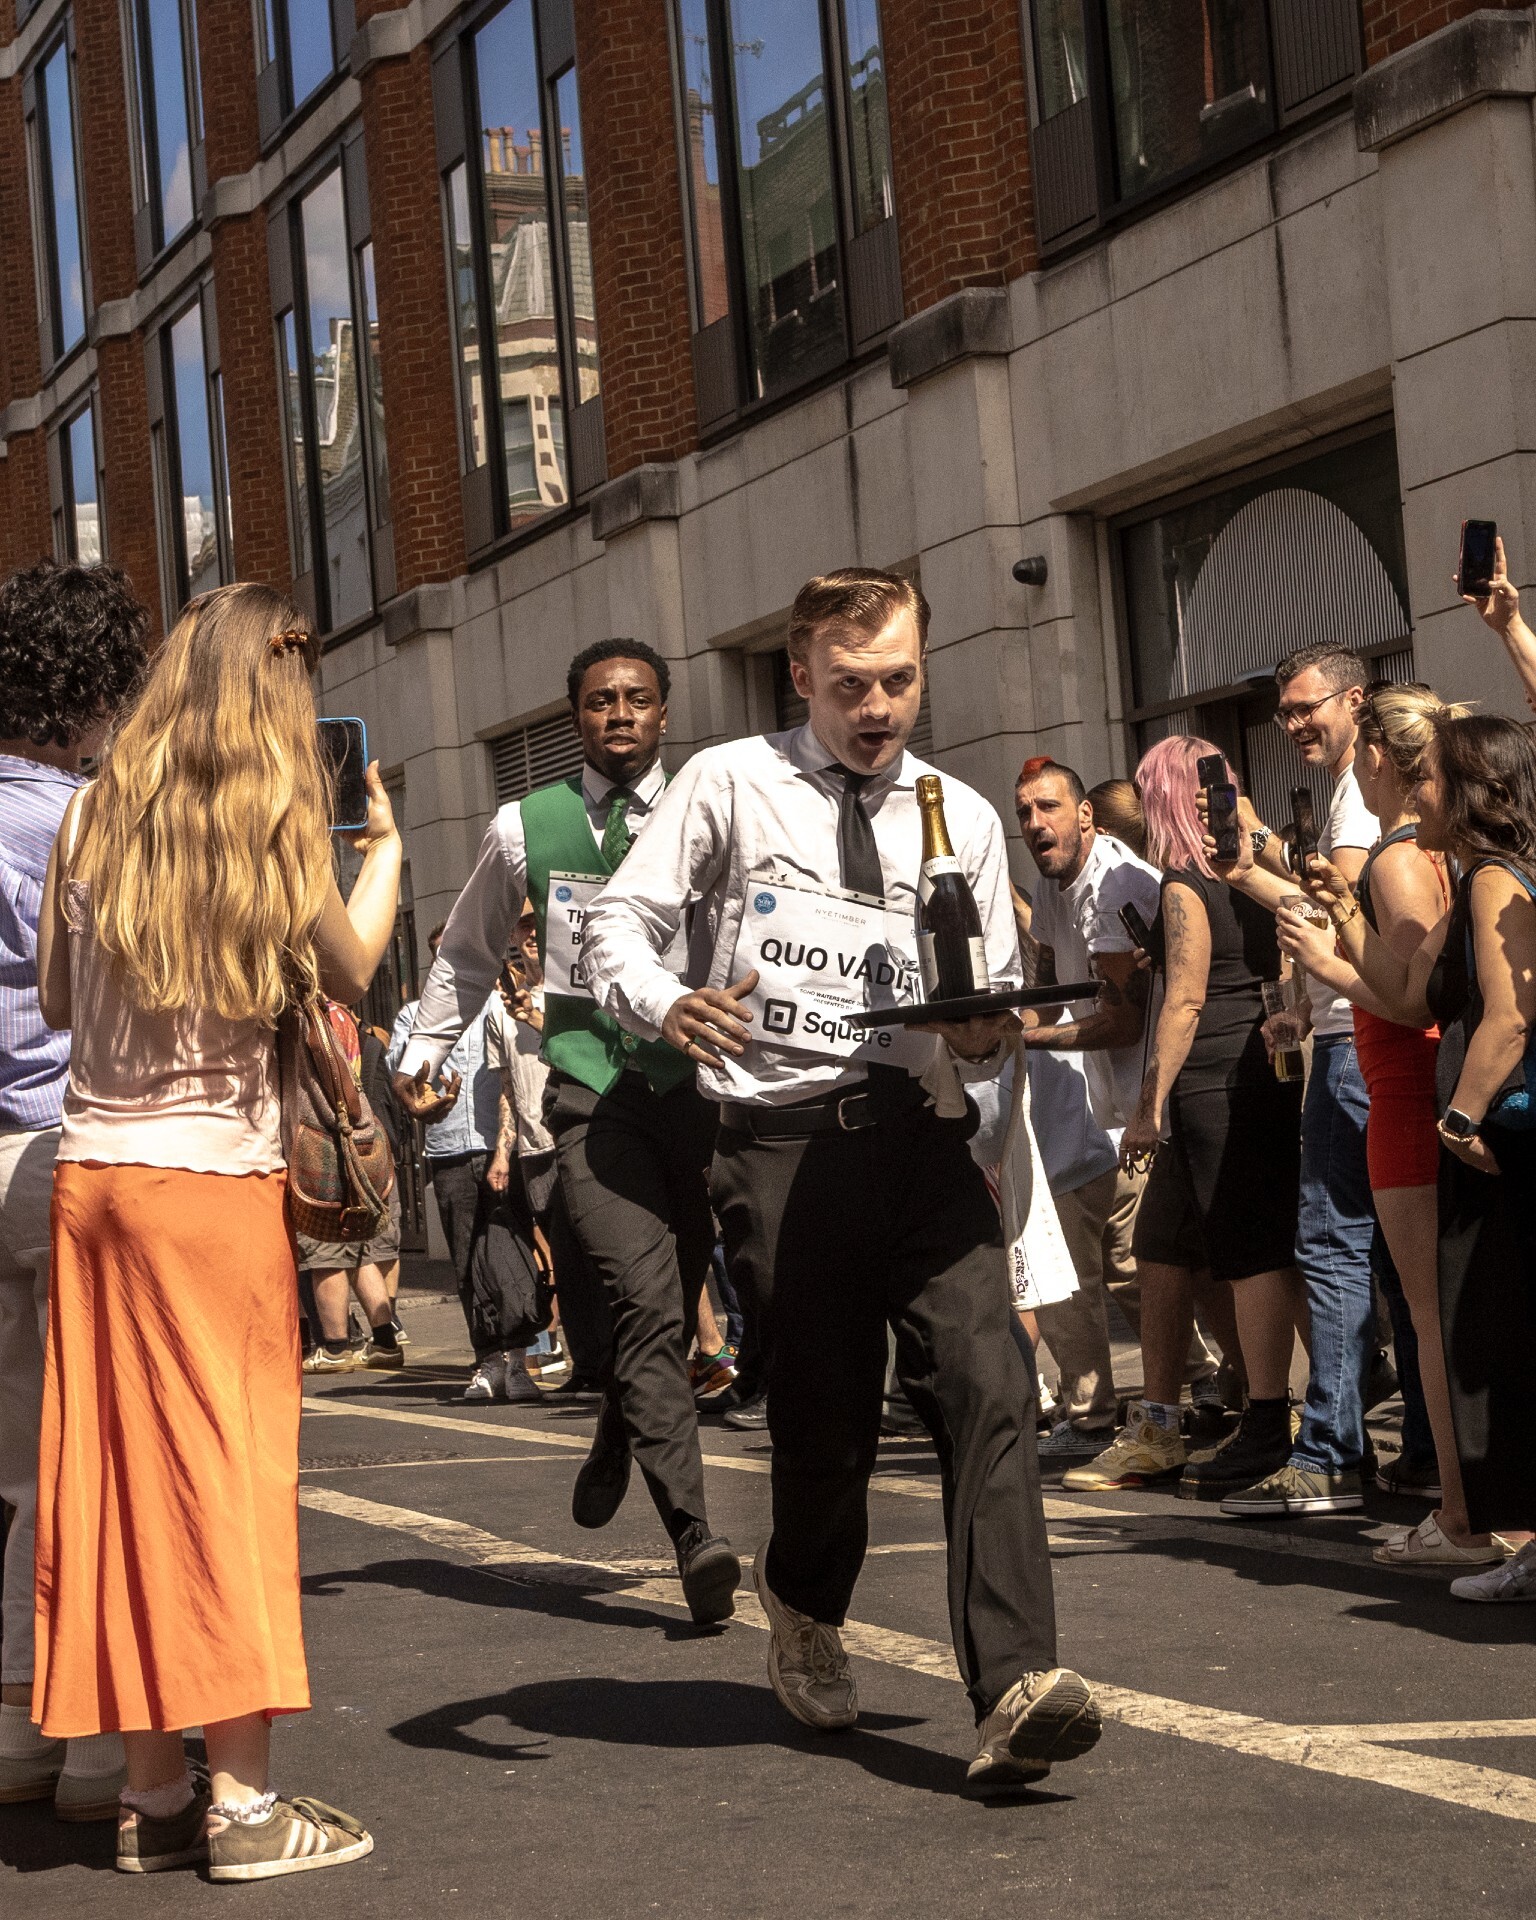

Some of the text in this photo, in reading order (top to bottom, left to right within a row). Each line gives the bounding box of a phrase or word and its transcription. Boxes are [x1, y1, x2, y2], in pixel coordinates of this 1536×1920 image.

[815, 908, 867, 925] NYETIMBER
[1292, 902, 1323, 918] Beer
[760, 938, 828, 971] QUO
[813, 998, 845, 1009] PRESENTED
[816, 991, 841, 1002] WAITERS
[840, 996, 856, 1005] RACE
[802, 1011, 892, 1048] Square
